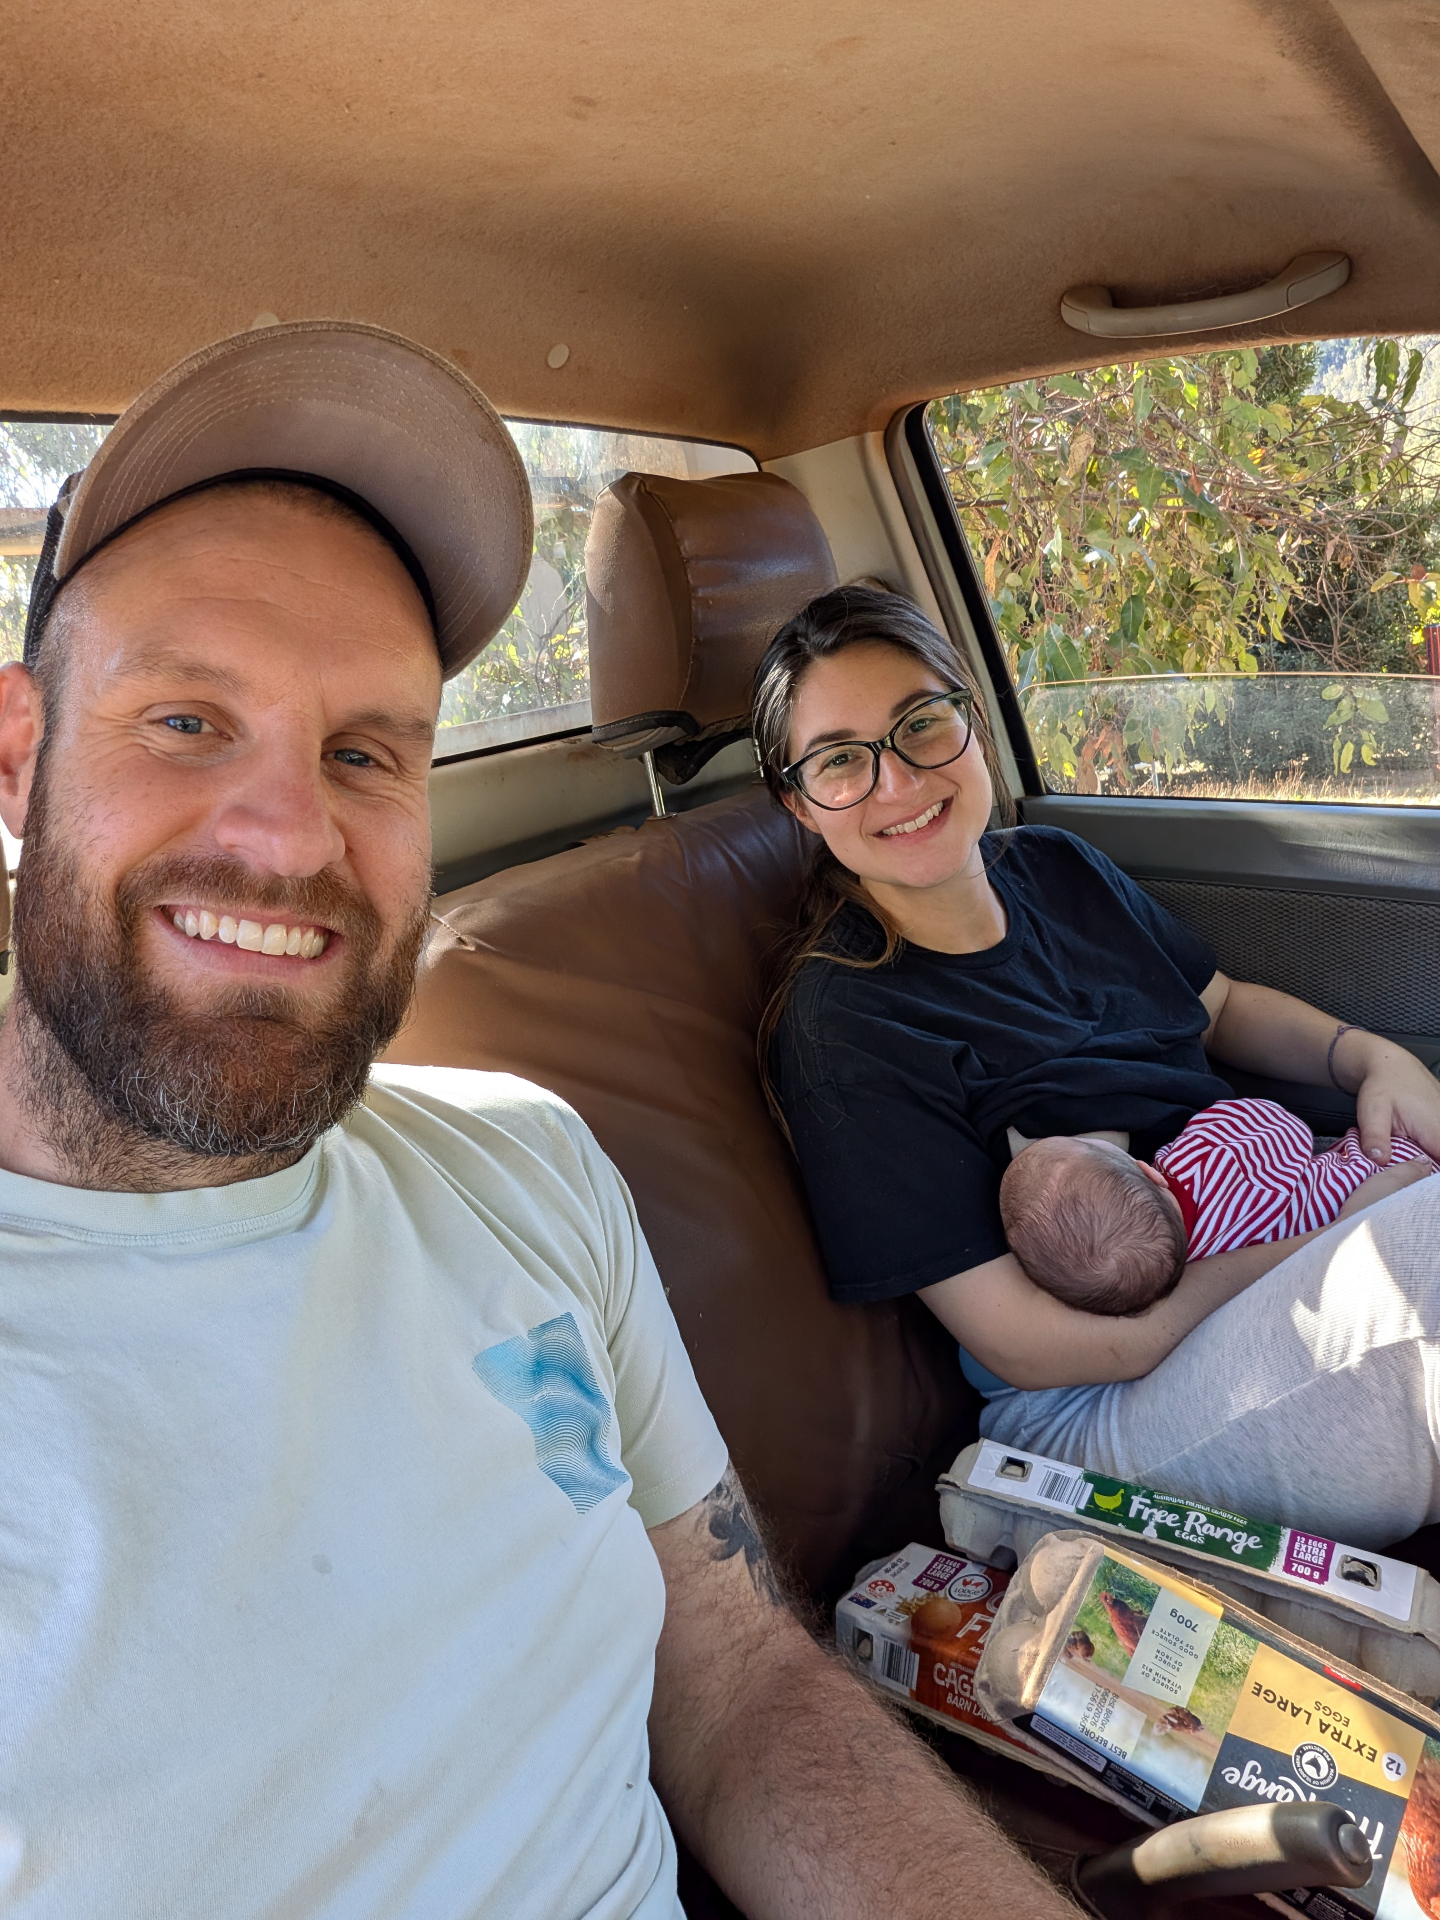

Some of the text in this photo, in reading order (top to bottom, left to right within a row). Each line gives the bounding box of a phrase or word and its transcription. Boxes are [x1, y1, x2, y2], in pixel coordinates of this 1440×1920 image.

[1129, 1495, 1263, 1554] Free Range
[1175, 1530, 1205, 1545] EGGS
[1296, 1535, 1328, 1550] 12 EGGS
[1293, 1550, 1324, 1565] LARGE
[1294, 1542, 1326, 1558] EXTRA
[927, 1569, 950, 1581] LARGE
[932, 1562, 957, 1575] EXTRA
[1291, 1563, 1320, 1580] 700 g
[918, 1577, 934, 1588] 700
[1170, 1608, 1199, 1633] 700g
[1151, 1629, 1199, 1660] GOOD SOURCE
[1160, 1628, 1194, 1651] OF FOLATE
[1154, 1654, 1180, 1672] SOURCE
[1156, 1649, 1183, 1667] OF IRON
[1152, 1676, 1178, 1695] SOURCE
[1154, 1671, 1182, 1691] VITAMIN
[946, 1692, 993, 1721] BARN LA
[1099, 1692, 1119, 1732] Best Before
[1314, 1700, 1351, 1728] EGGS
[1251, 1681, 1402, 1776] 12 EXTRA LARGE
[1108, 1743, 1128, 1760] BEST
